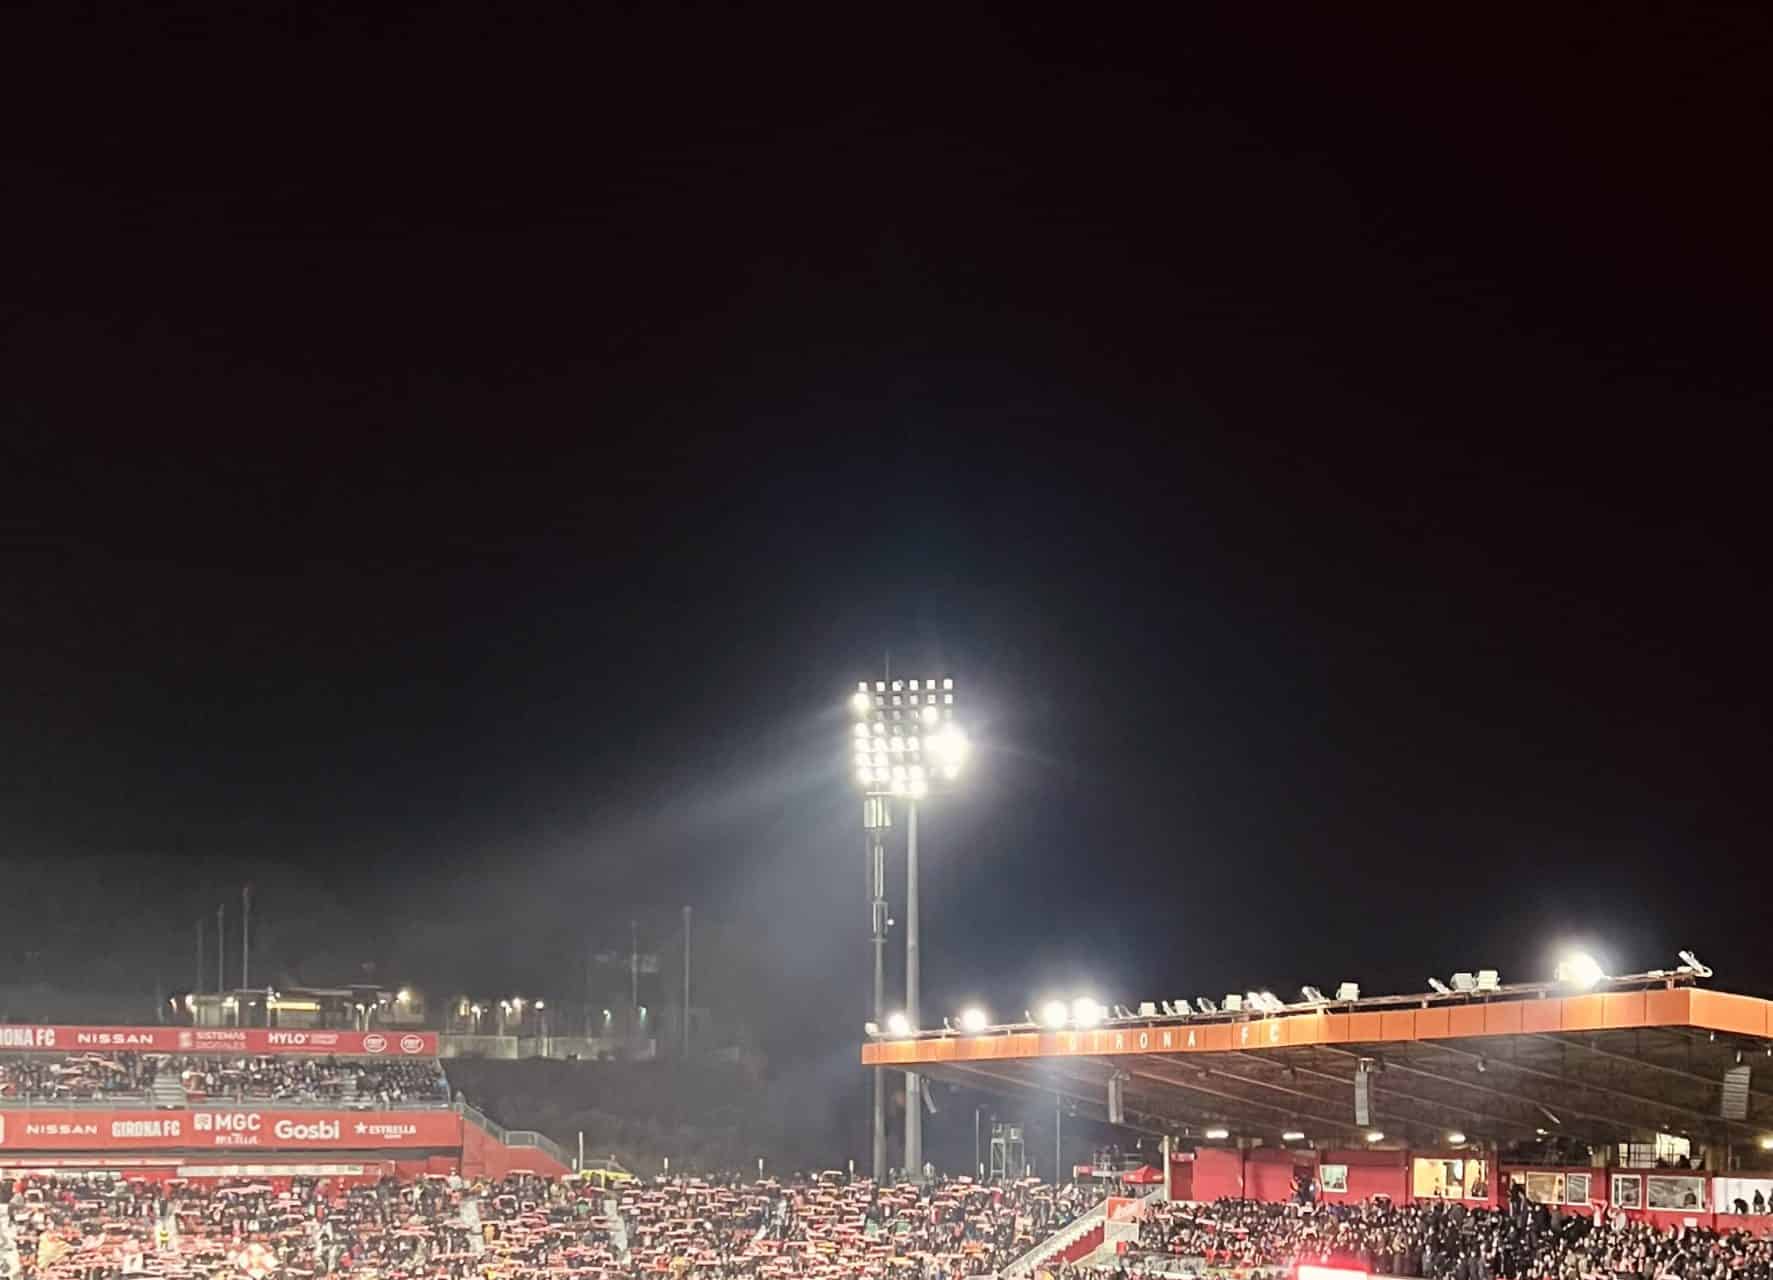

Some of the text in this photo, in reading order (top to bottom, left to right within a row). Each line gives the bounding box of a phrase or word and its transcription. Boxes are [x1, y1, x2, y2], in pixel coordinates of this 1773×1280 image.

[36, 1028, 56, 1046] FC
[77, 1033, 153, 1044] NISSAN
[26, 1123, 97, 1135] NISSAN
[112, 1120, 181, 1137] GIRONA FC
[215, 1114, 261, 1131] MGC
[274, 1120, 340, 1140] Gosbi
